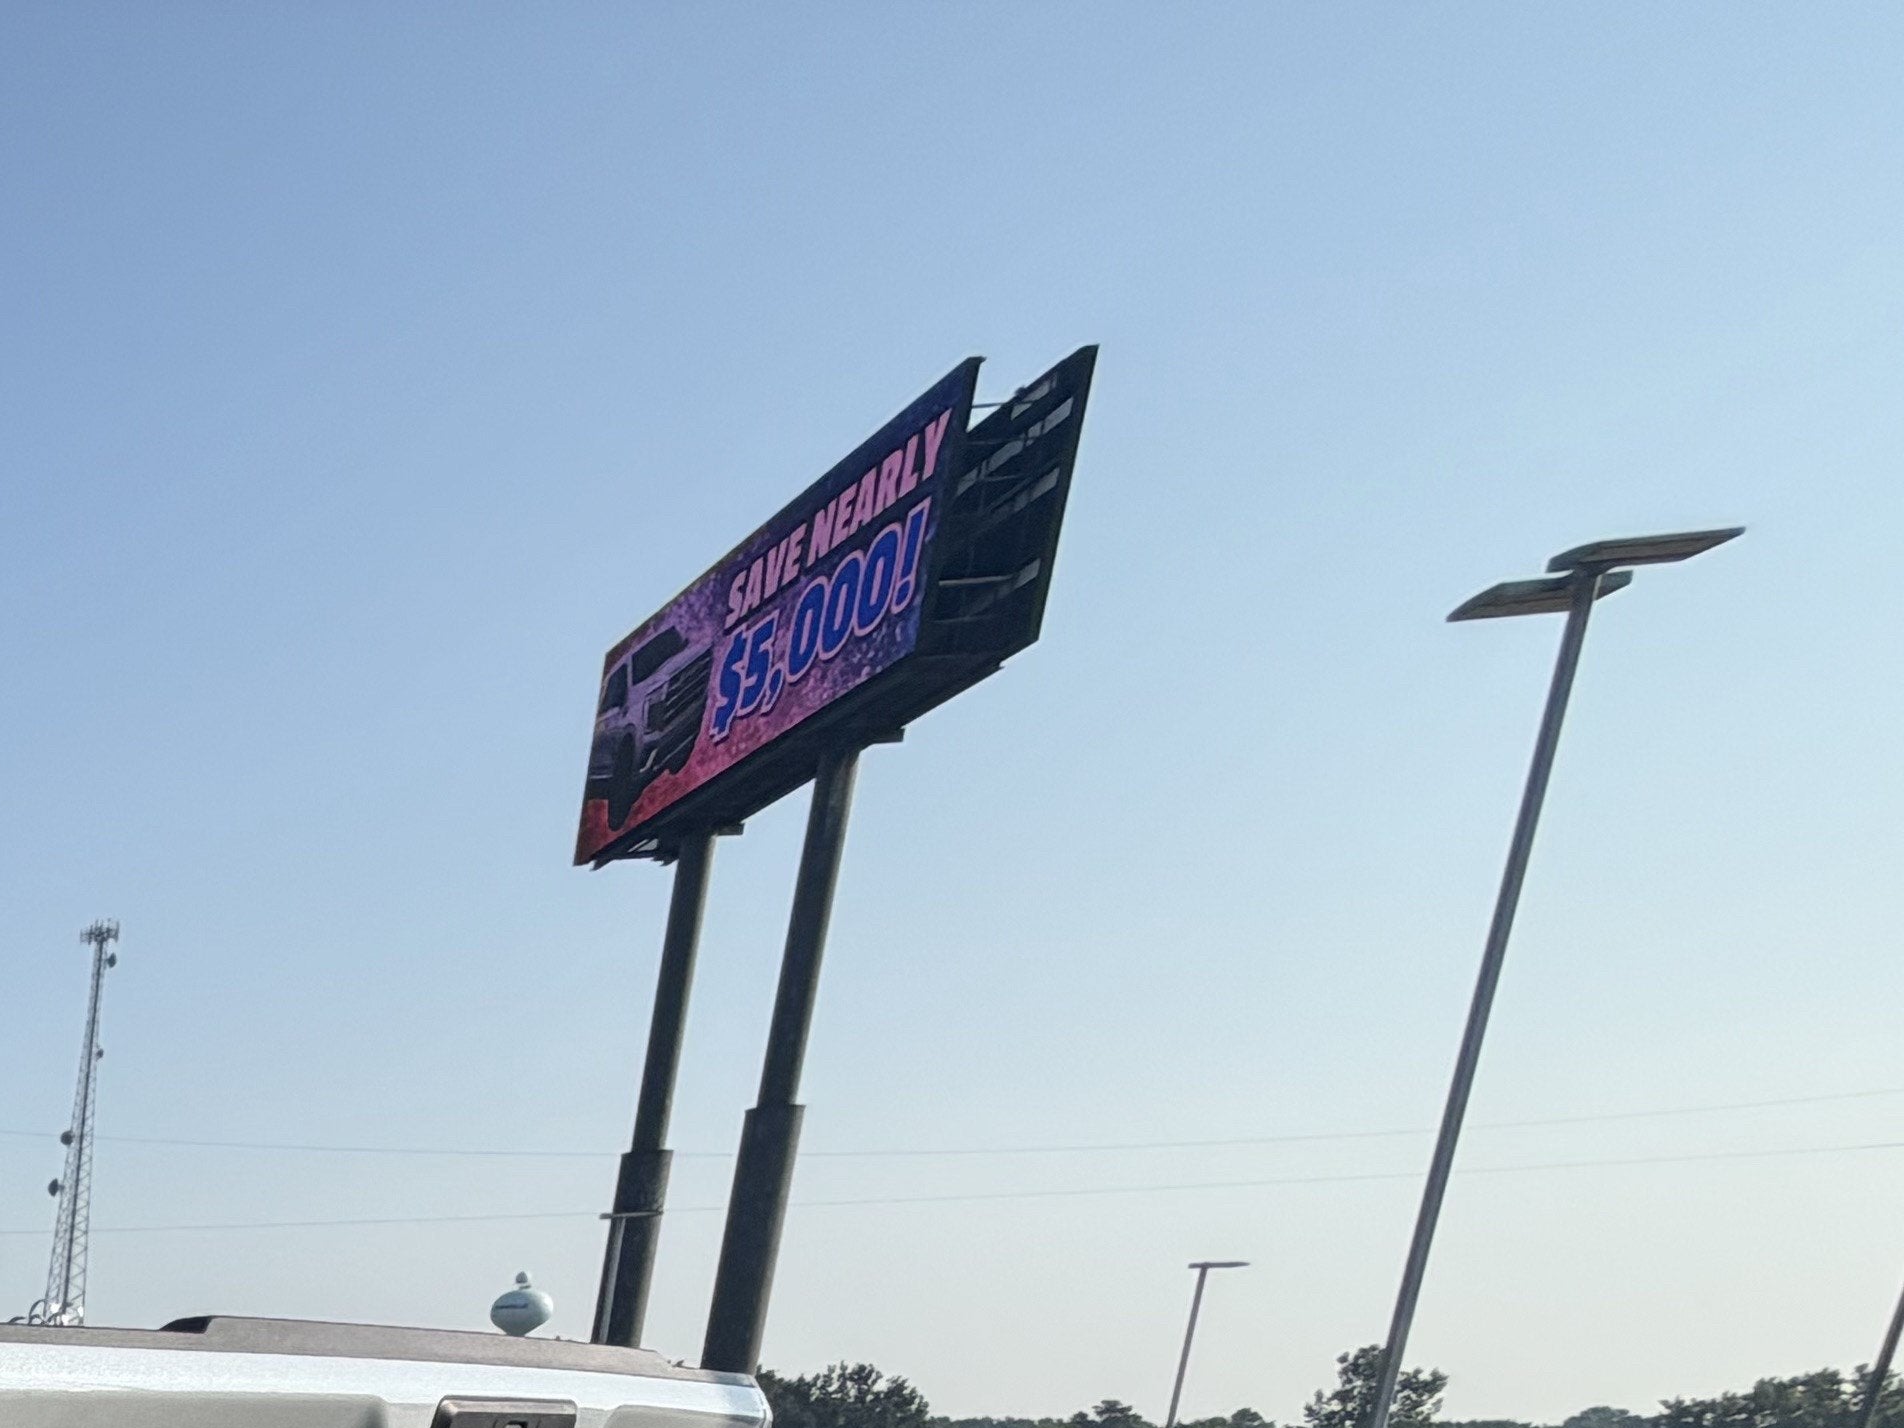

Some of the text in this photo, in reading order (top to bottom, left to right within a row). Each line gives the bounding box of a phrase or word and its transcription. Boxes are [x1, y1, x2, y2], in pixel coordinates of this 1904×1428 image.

[709, 496, 932, 742] $5,000!
[724, 408, 952, 620] SAVE NEARLY
